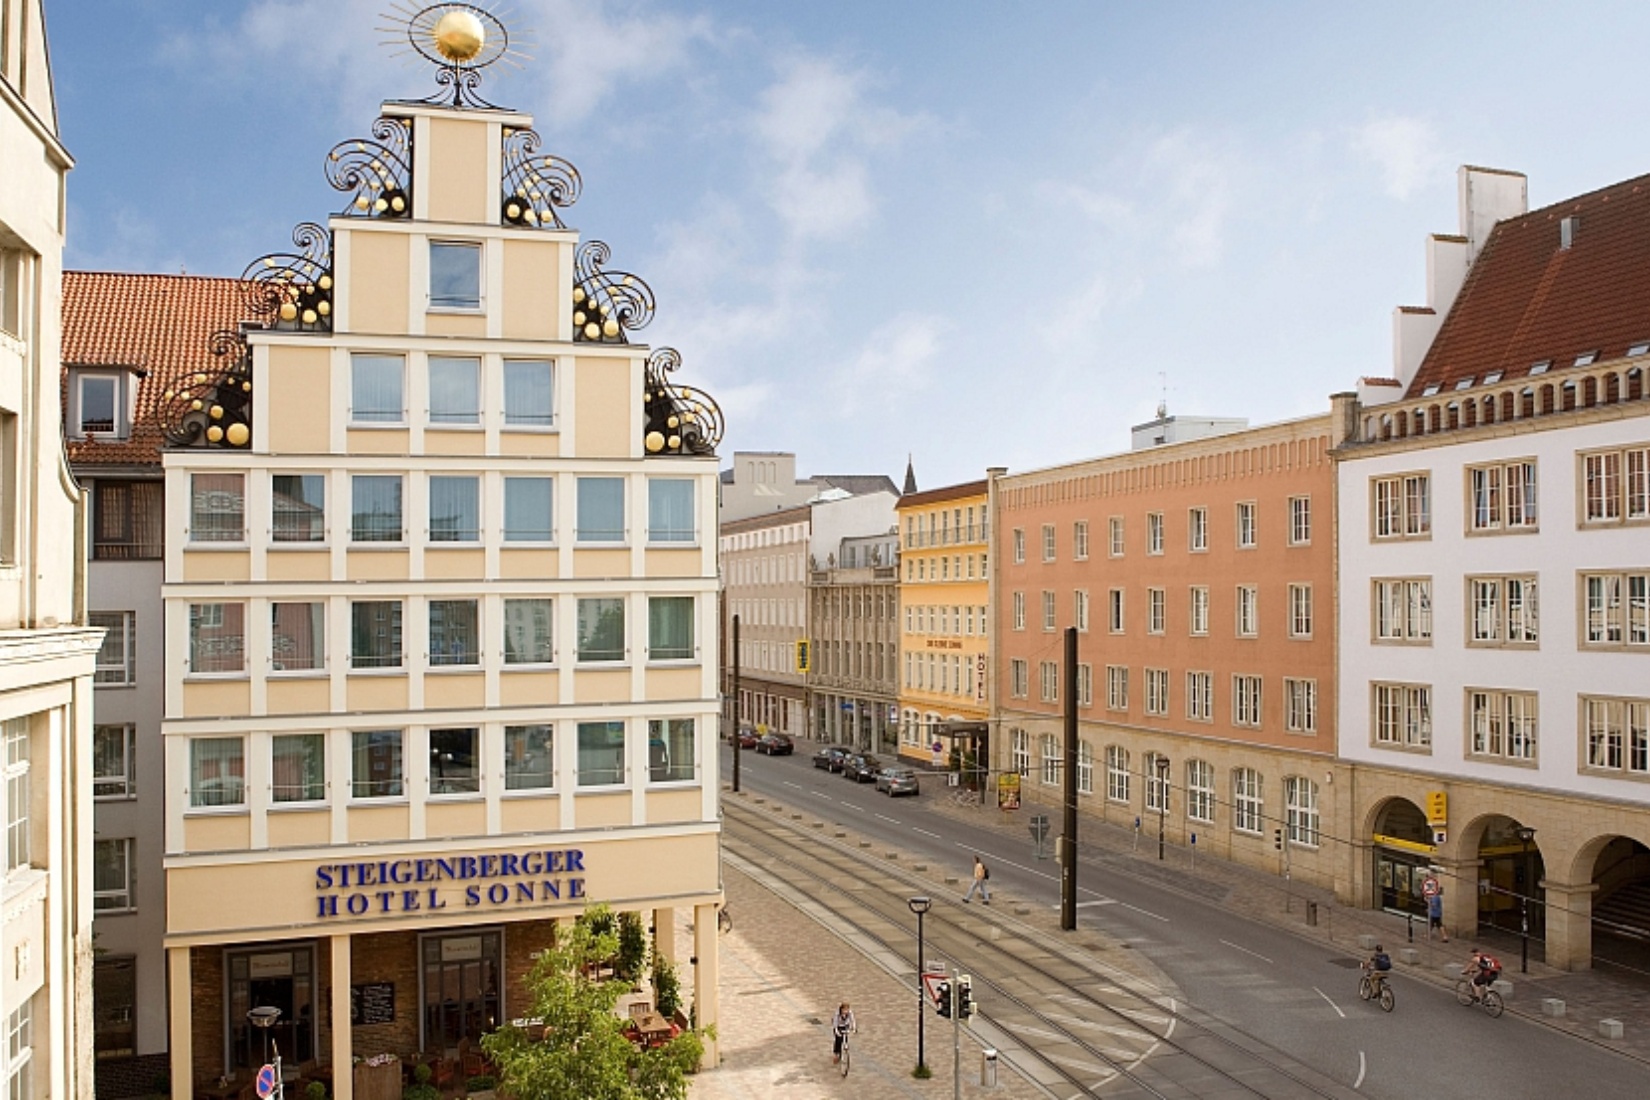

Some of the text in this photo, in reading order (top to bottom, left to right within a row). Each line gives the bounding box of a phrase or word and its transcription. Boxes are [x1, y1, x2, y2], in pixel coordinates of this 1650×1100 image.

[977, 653, 985, 699] HOTEL
[316, 849, 585, 890] STEIGENBERGER
[317, 877, 586, 918] HOTEL SONNE
